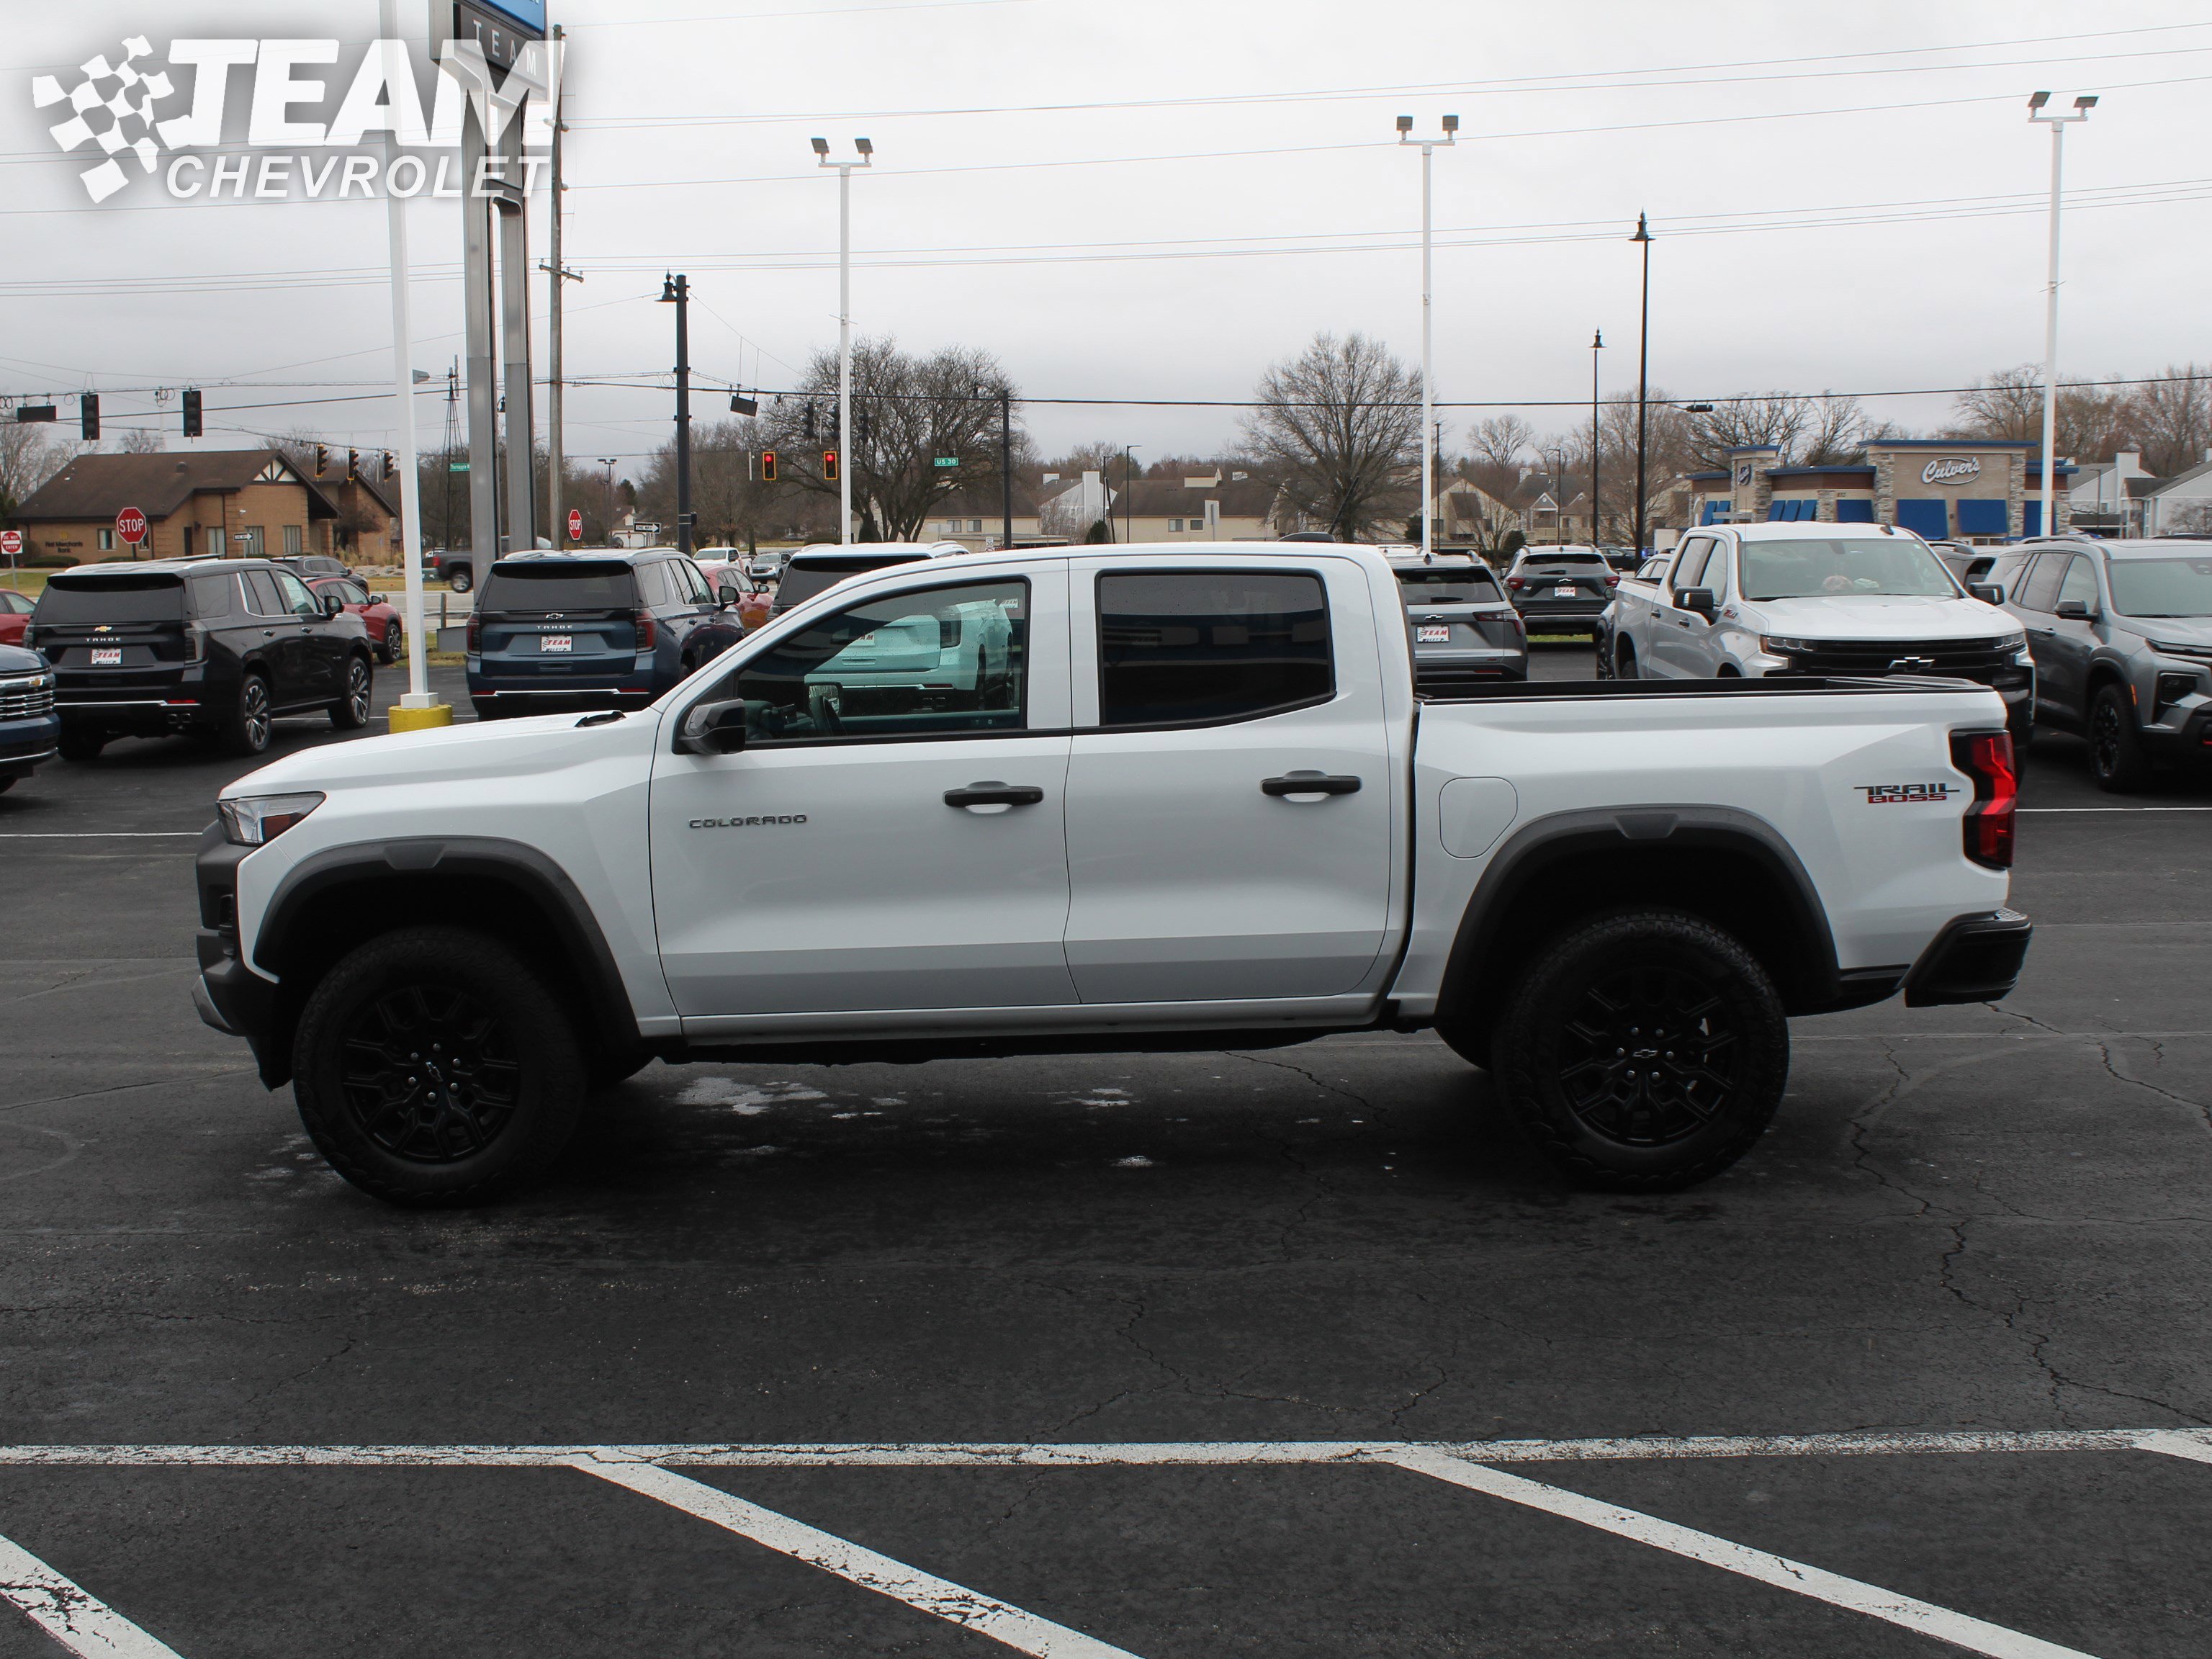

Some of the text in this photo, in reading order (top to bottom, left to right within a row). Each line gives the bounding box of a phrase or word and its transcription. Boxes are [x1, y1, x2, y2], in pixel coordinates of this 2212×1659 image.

[472, 19, 536, 76] TEAM
[1922, 457, 1980, 484] Culver's
[119, 518, 144, 533] STOP
[570, 519, 581, 531] STOP
[1853, 783, 1960, 796] TRAIL
[1869, 793, 1947, 804] BOSS
[688, 814, 807, 829] COLORADO
